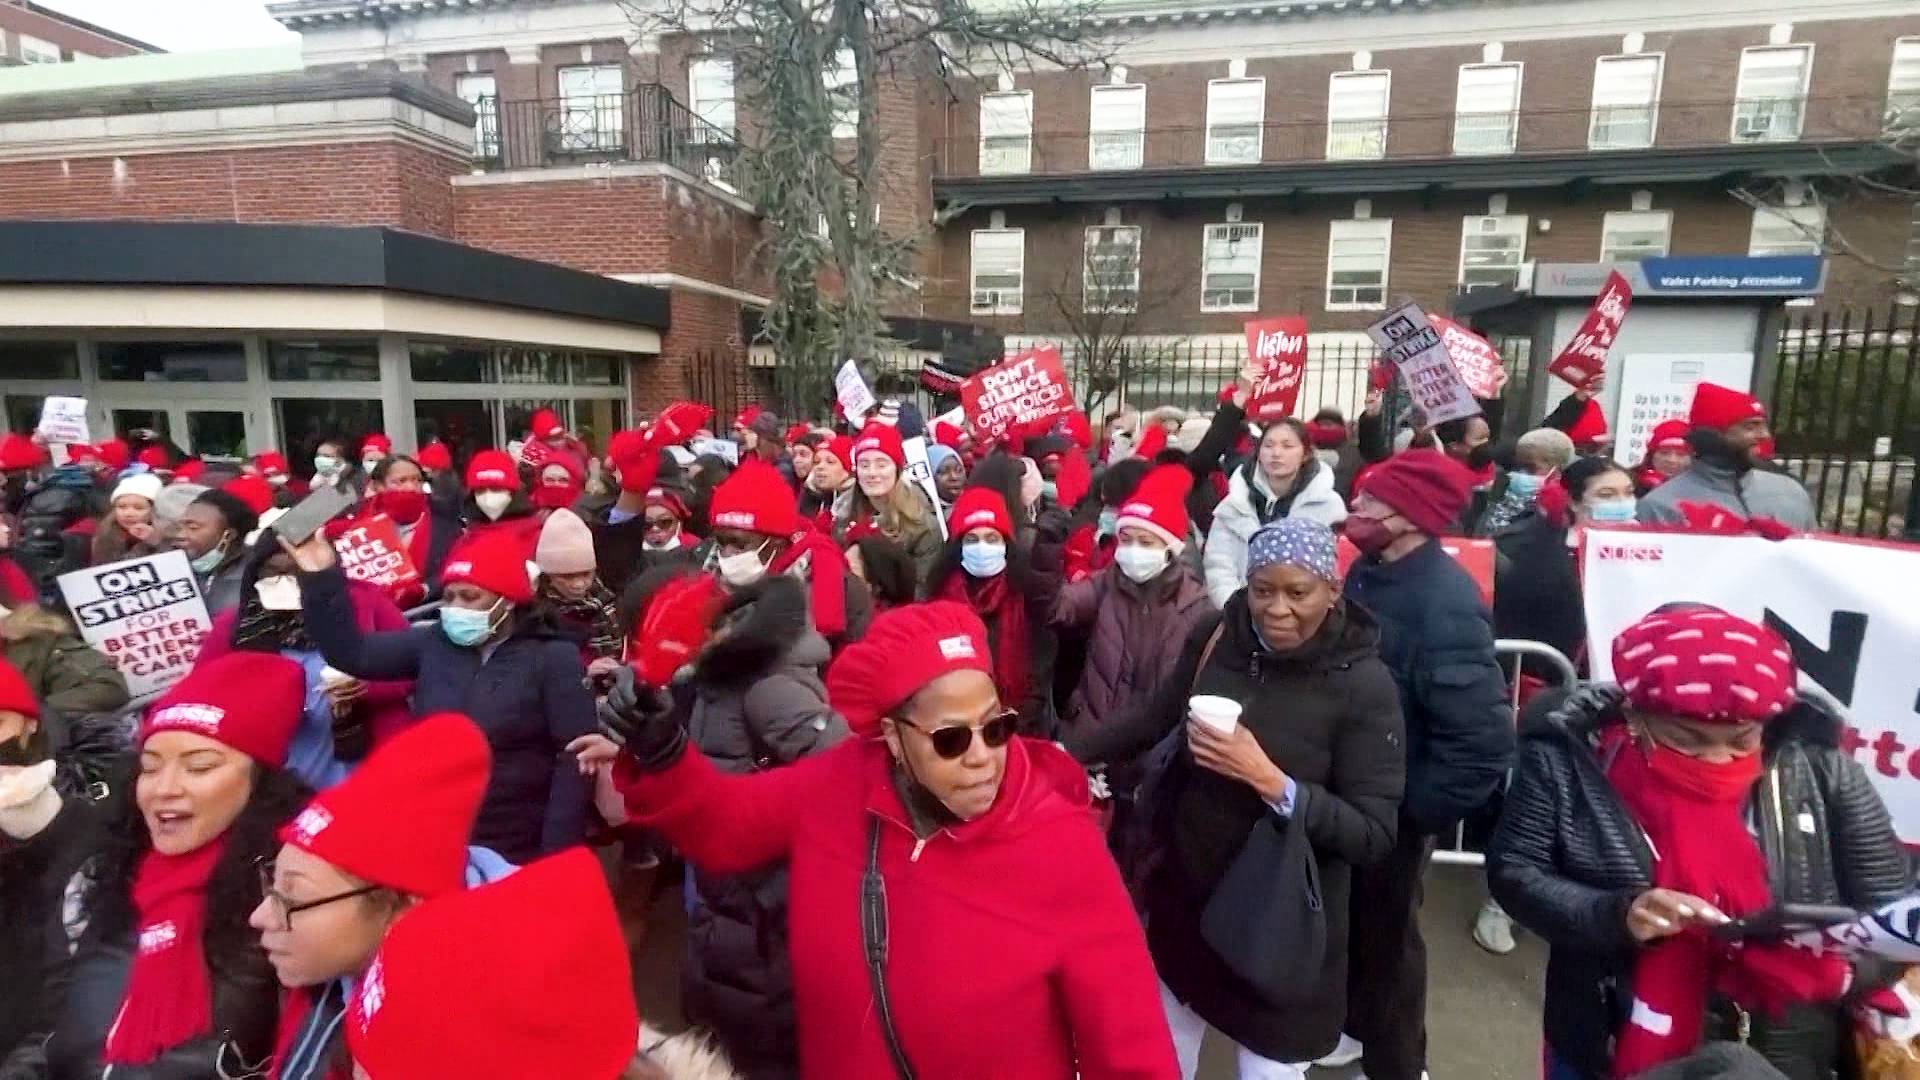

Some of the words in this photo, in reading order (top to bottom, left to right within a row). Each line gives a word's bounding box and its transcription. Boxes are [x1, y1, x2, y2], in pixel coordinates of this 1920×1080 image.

[1660, 277, 1691, 286] Valet
[1692, 277, 1738, 288] Parking
[1739, 277, 1803, 286] Attendant
[983, 357, 1035, 391] DON'T
[978, 370, 1051, 410] SILENCE
[341, 539, 388, 568] NCE
[100, 563, 158, 593] ON
[79, 580, 195, 625] STRIKE
[104, 618, 199, 652] BETTER
[125, 610, 171, 631] FOR
[131, 650, 196, 676] CARE
